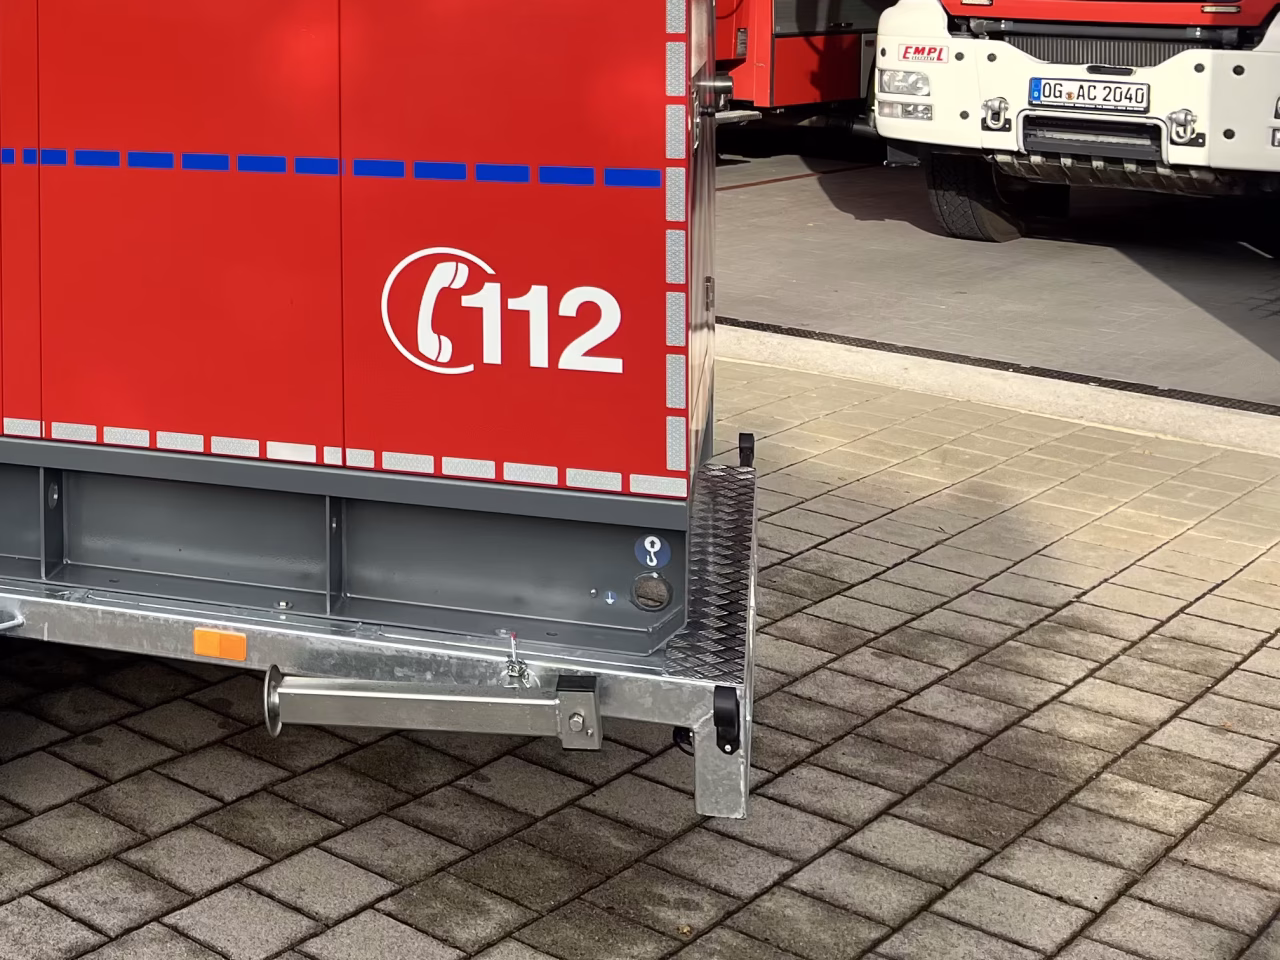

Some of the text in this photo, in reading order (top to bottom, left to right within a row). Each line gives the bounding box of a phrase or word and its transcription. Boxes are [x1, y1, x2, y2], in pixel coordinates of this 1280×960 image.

[902, 45, 943, 61] EMPL
[1042, 82, 1063, 99] OG
[1076, 84, 1097, 101] AC
[1102, 85, 1144, 104] 2040
[460, 281, 624, 374] 112
